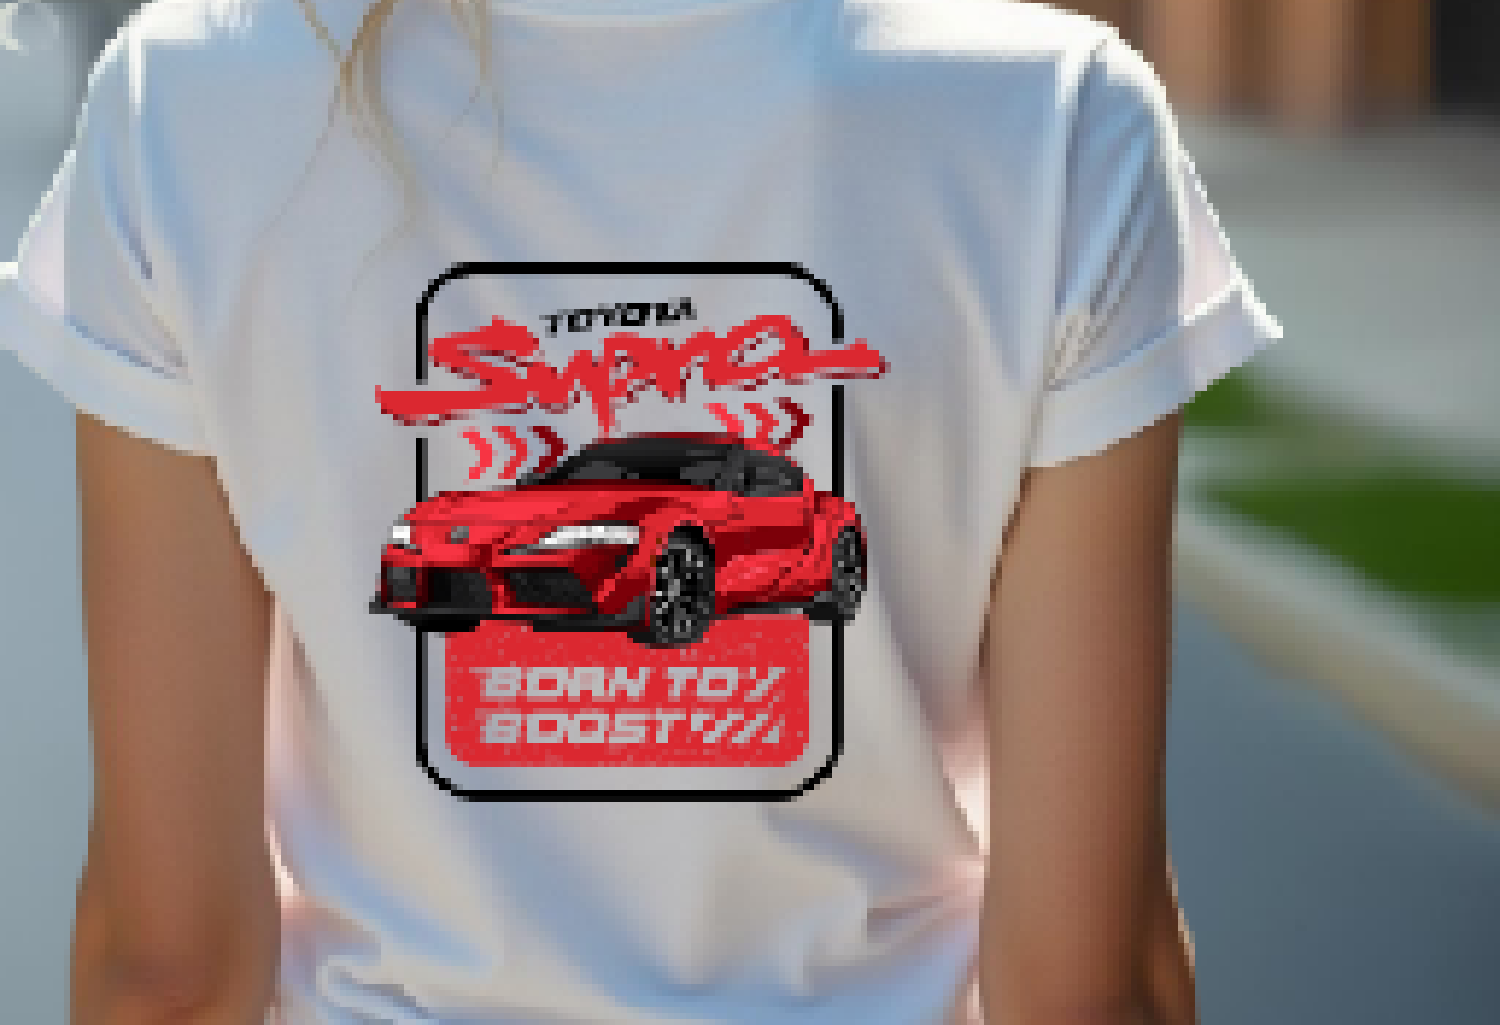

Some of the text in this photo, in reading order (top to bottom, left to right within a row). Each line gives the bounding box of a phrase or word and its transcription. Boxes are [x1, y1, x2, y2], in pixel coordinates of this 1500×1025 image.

[472, 666, 741, 702] BORN TO
[476, 709, 686, 743] BOOST
